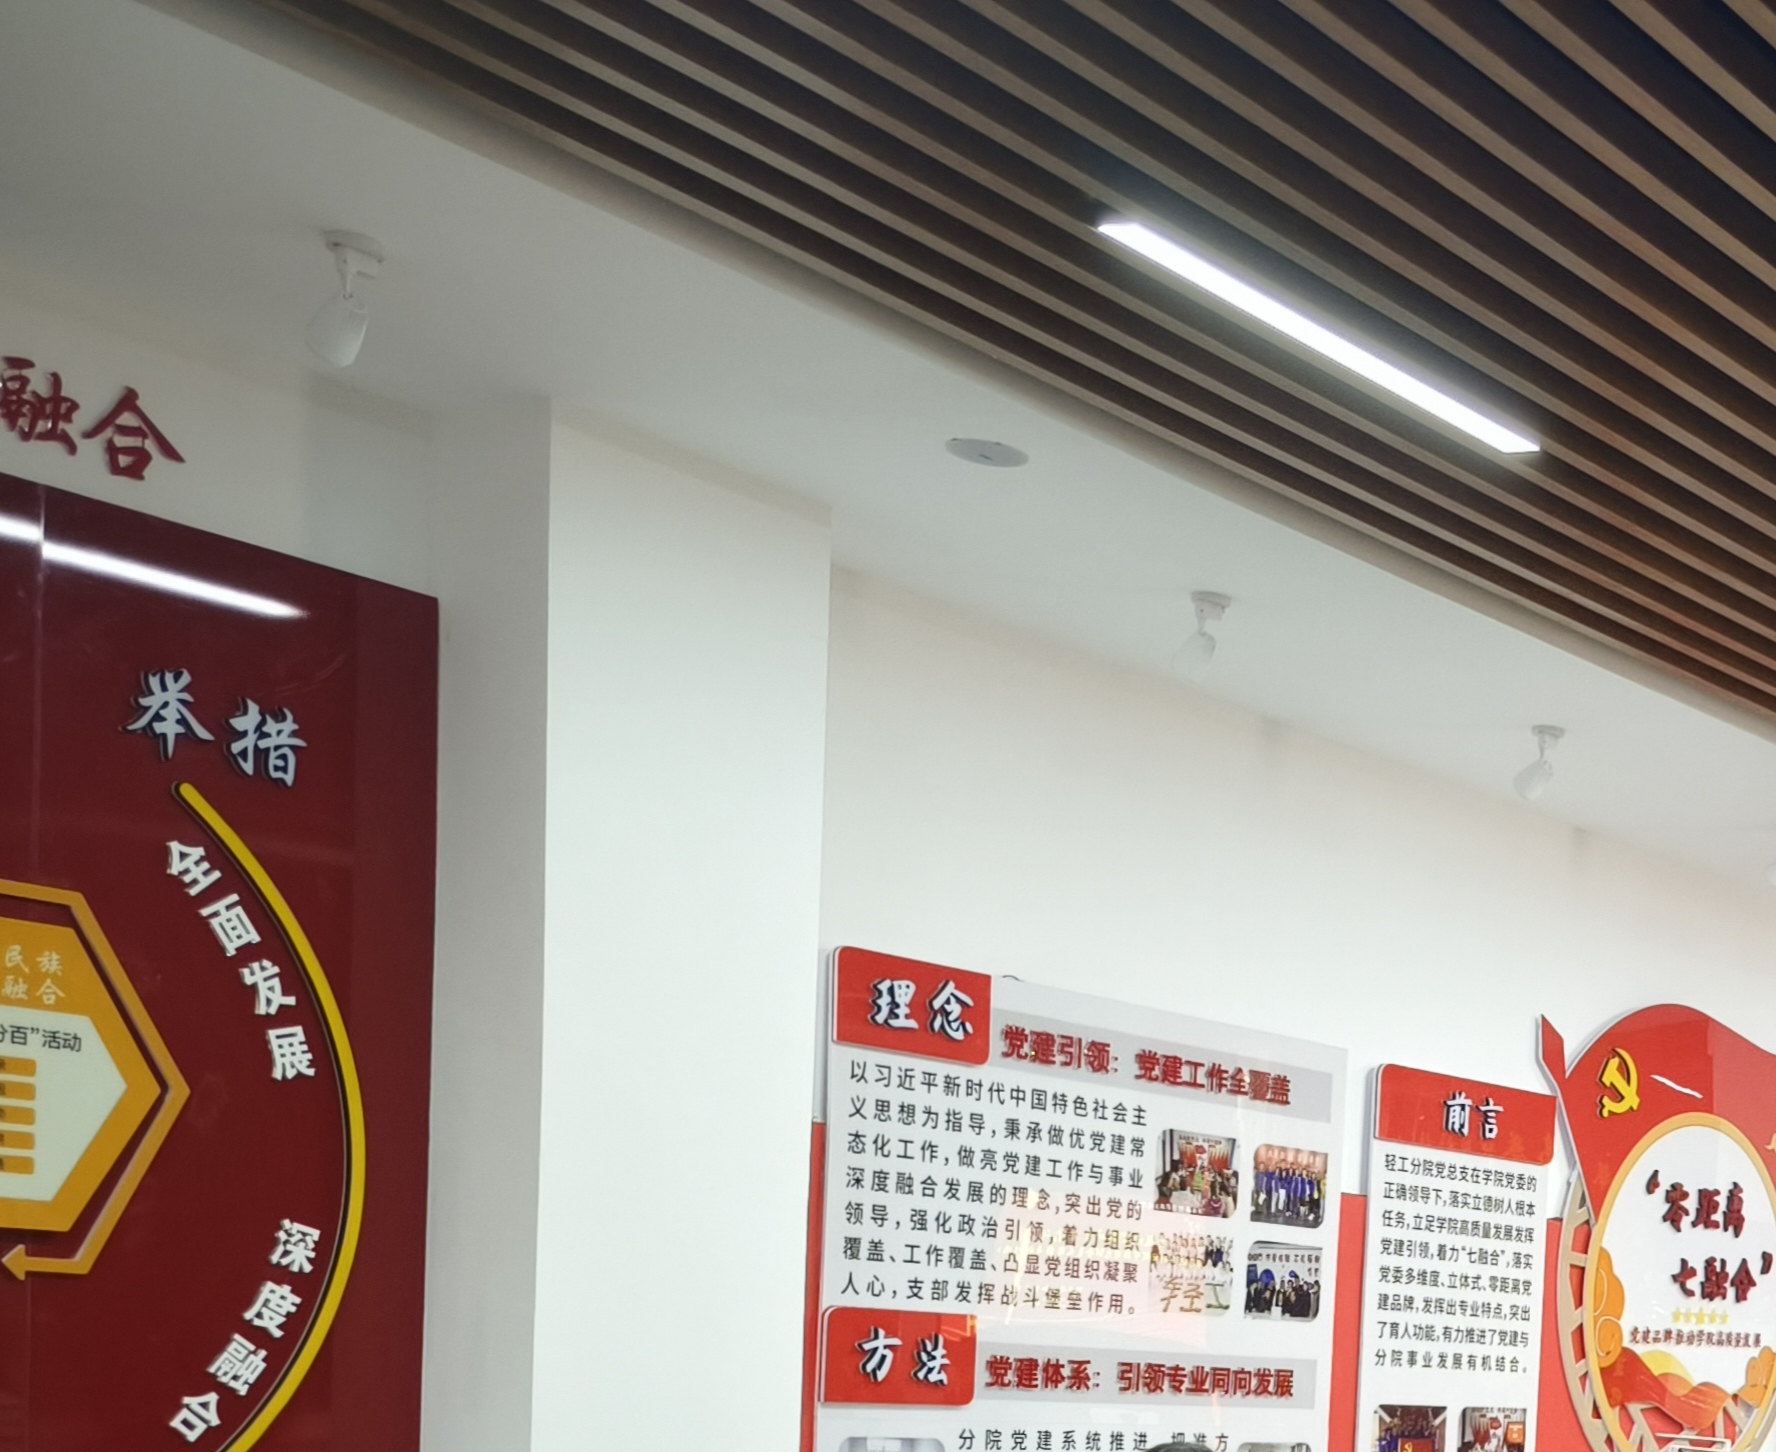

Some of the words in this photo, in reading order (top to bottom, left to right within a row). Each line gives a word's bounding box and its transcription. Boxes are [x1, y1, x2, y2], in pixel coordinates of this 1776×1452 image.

[122, 667, 308, 788] 举措
[166, 839, 316, 1082] 全面发展
[869, 977, 974, 1041] 理念
[849, 1059, 1148, 1127] 以习近平新时代中国特色社会主
[1443, 1090, 1504, 1140] 前言
[1384, 1153, 1537, 1193] 轻工分院党总支在学院党委的
[168, 1218, 320, 1443] 深度融合
[855, 1327, 950, 1386] 方法
